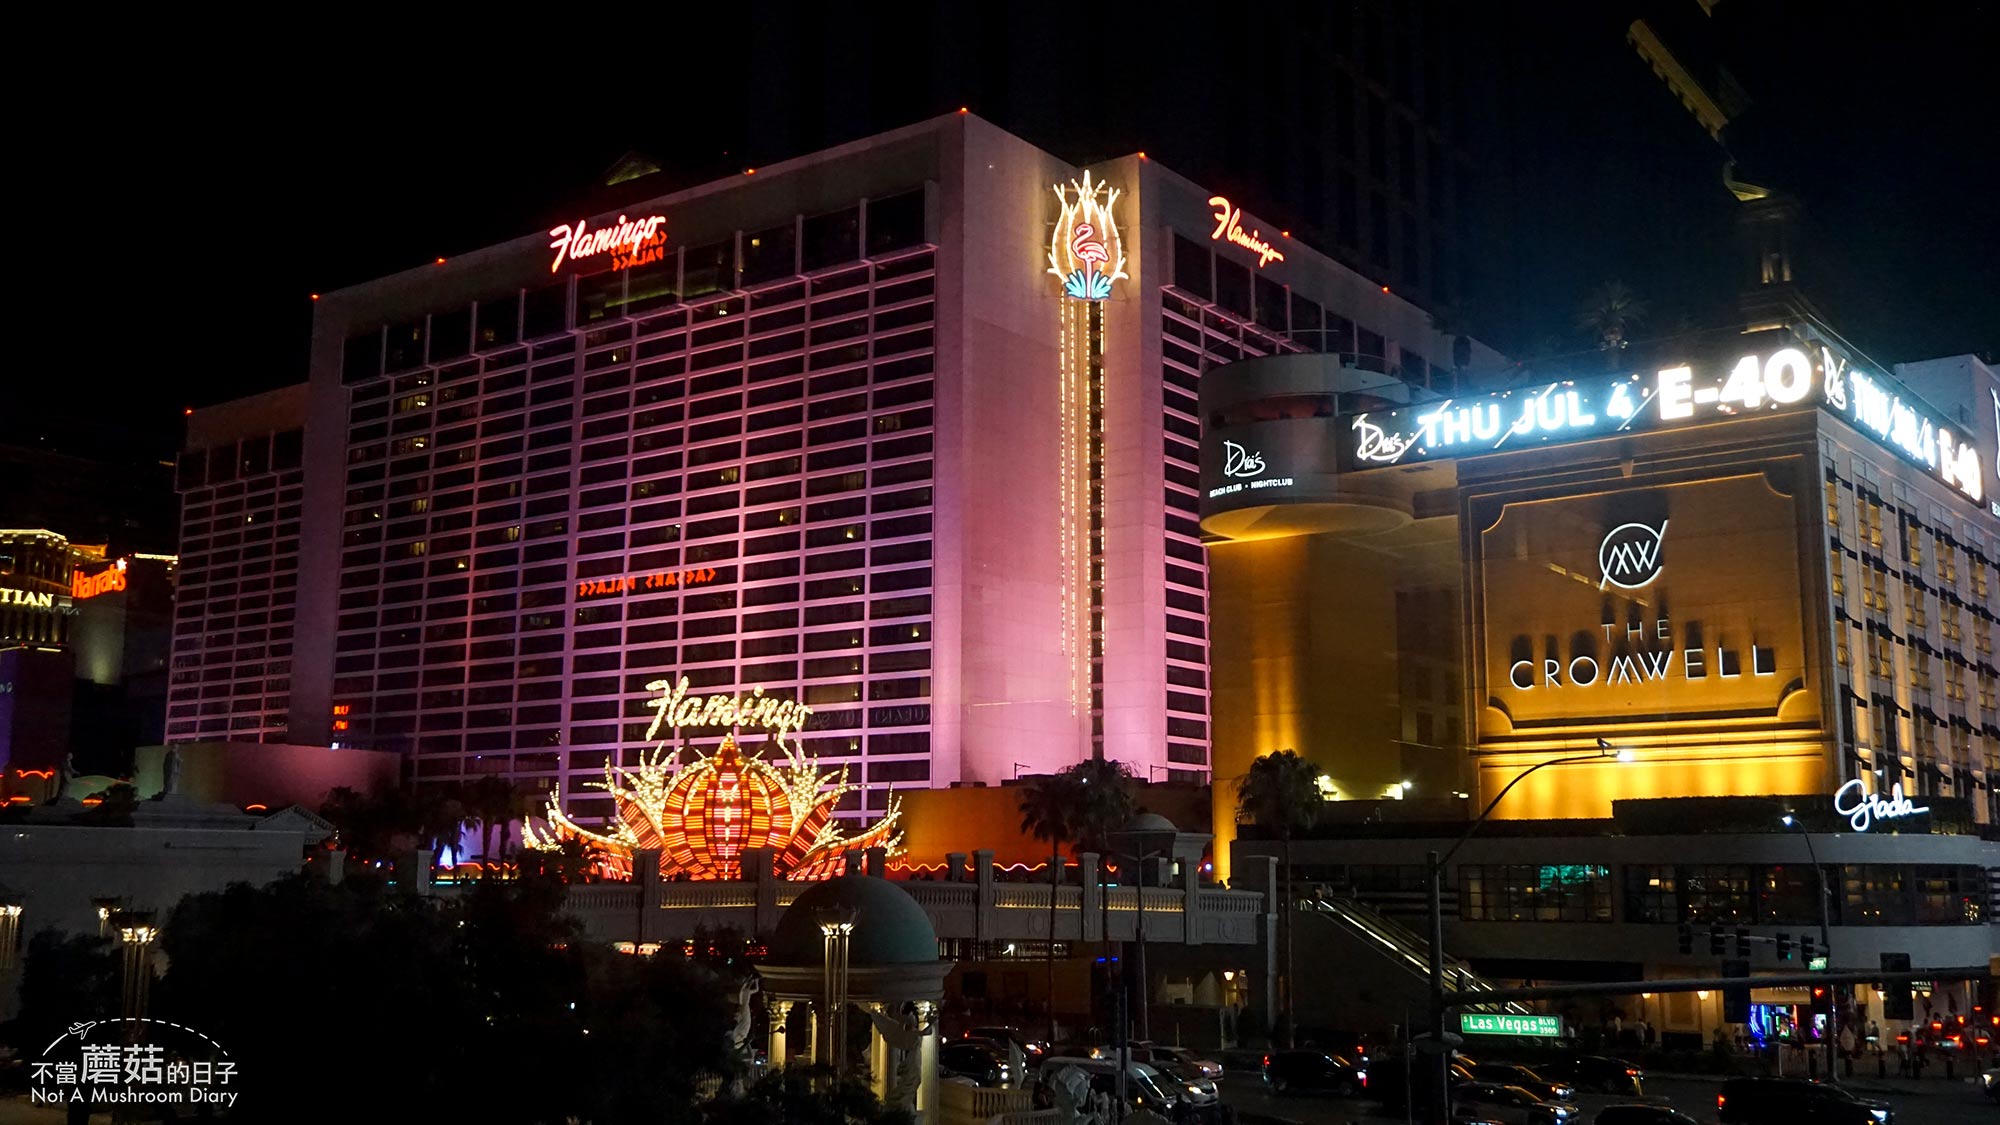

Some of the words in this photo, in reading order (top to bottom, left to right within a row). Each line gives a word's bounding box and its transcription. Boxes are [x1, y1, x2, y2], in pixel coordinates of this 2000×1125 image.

[549, 215, 666, 273] Flamingo
[1208, 196, 1285, 268] Flamingo
[1418, 404, 1500, 448] THU
[1513, 391, 1596, 435] JUL
[1606, 384, 1635, 419] 4
[1657, 347, 1813, 421] E-40
[1223, 440, 1266, 477] Drai's
[1226, 483, 1242, 495] CLUB
[1250, 478, 1294, 489] NIGHTCLUB
[0, 587, 54, 608] TIAN
[1601, 619, 1671, 644] THE
[1509, 644, 1776, 691] CROMWELL
[645, 676, 813, 745] Flamingo
[1469, 1016, 1493, 1030] Las
[1497, 1016, 1537, 1034] Vegas
